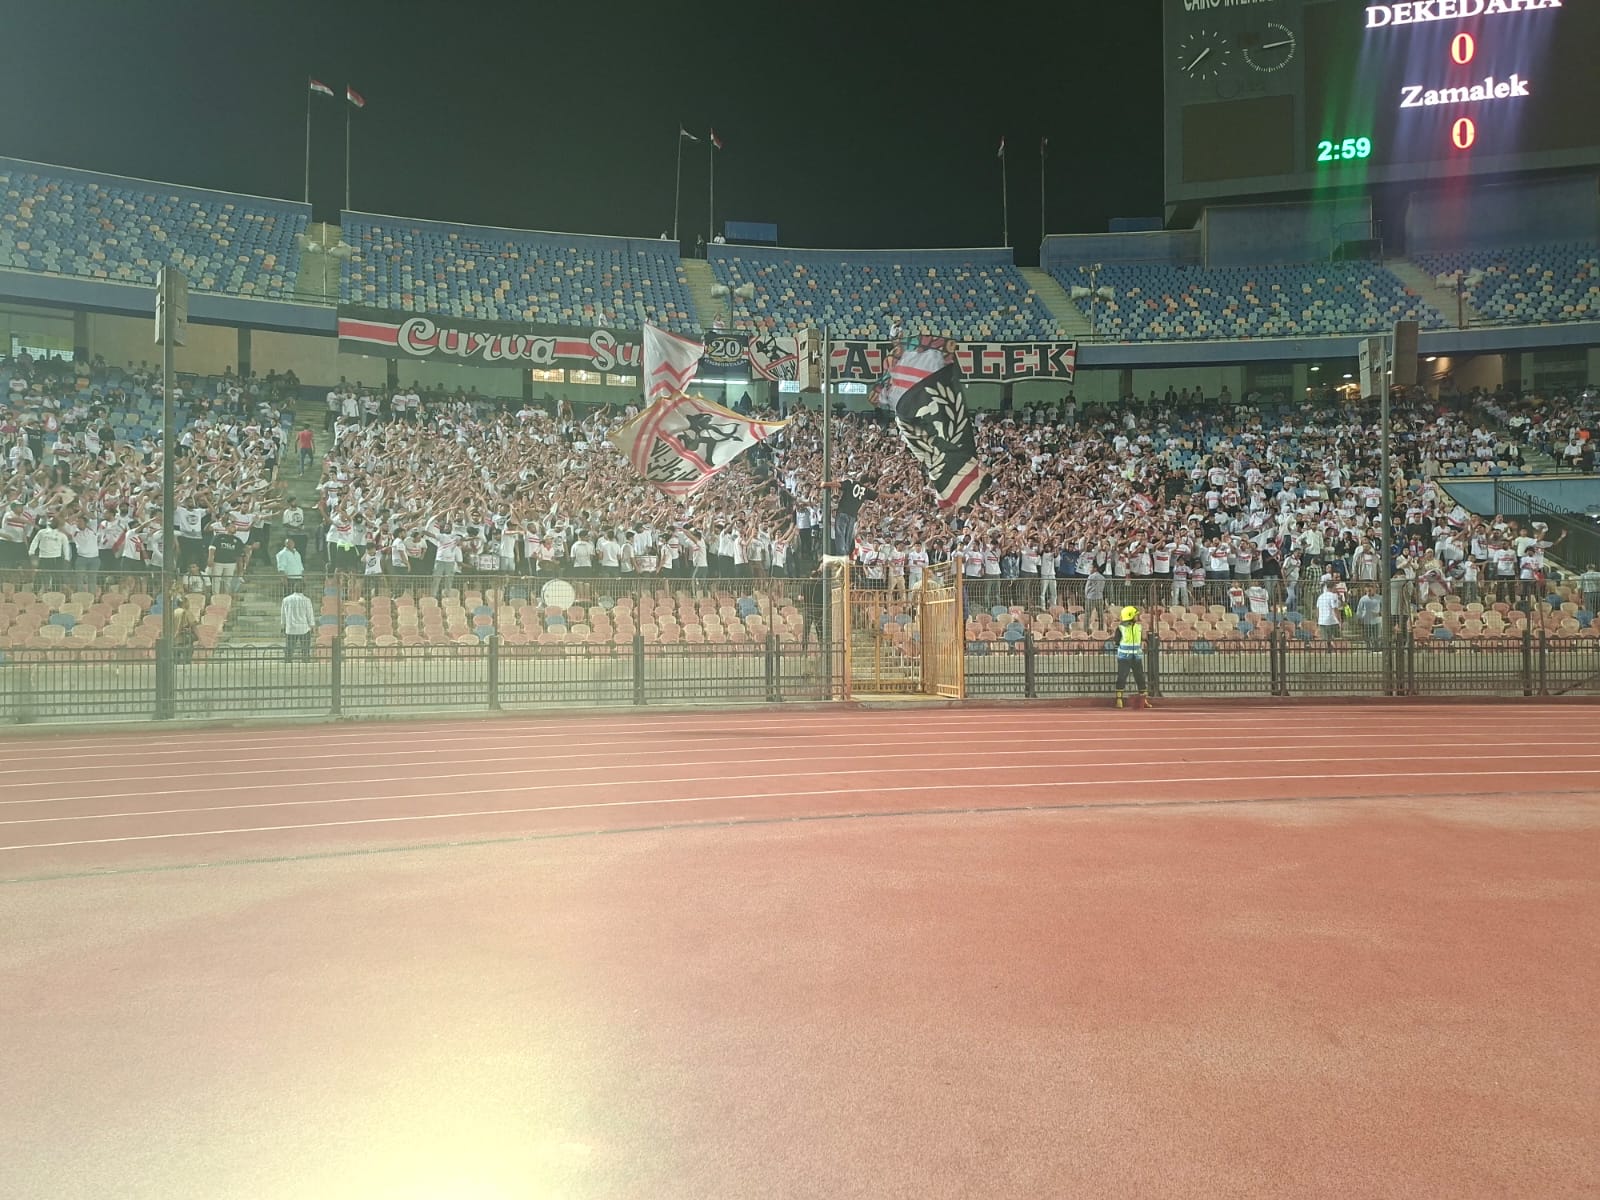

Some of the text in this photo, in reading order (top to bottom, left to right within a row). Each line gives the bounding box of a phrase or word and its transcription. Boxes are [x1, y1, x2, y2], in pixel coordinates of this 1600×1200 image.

[1451, 32, 1474, 65] 0
[1400, 73, 1530, 109] Zamalek
[1317, 137, 1371, 161] 2:59
[1452, 117, 1475, 149] 0
[398, 317, 644, 371] Curva Su
[711, 340, 740, 357] 20
